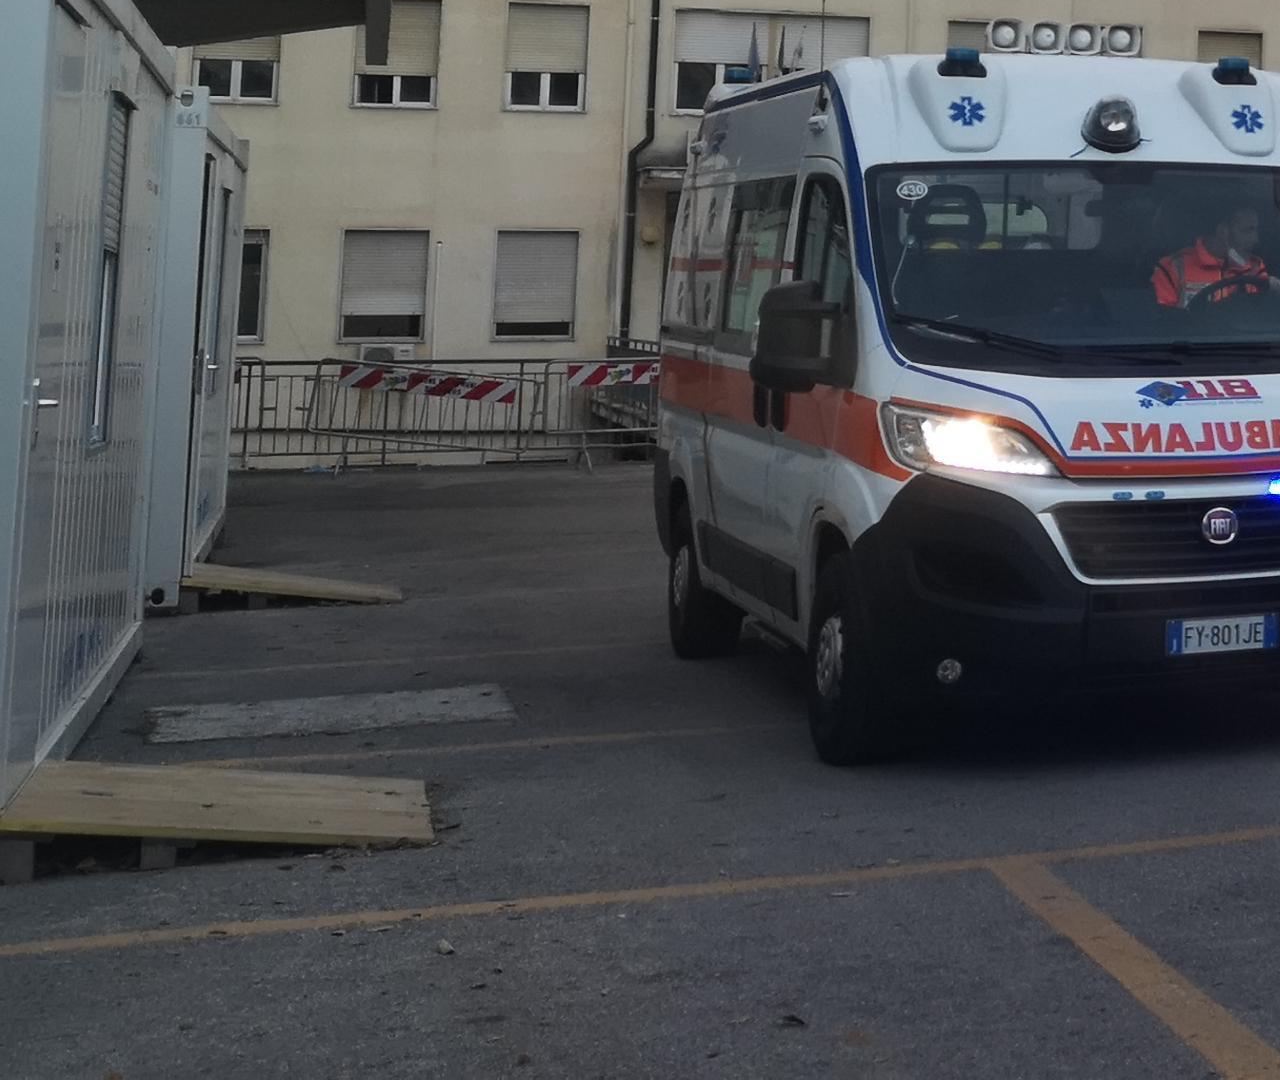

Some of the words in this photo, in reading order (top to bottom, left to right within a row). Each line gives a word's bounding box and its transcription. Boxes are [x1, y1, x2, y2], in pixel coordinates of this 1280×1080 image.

[901, 184, 924, 196] 430
[1210, 518, 1231, 535] FIAT
[1184, 626, 1205, 648] FY
[1210, 622, 1263, 646] 801JE
